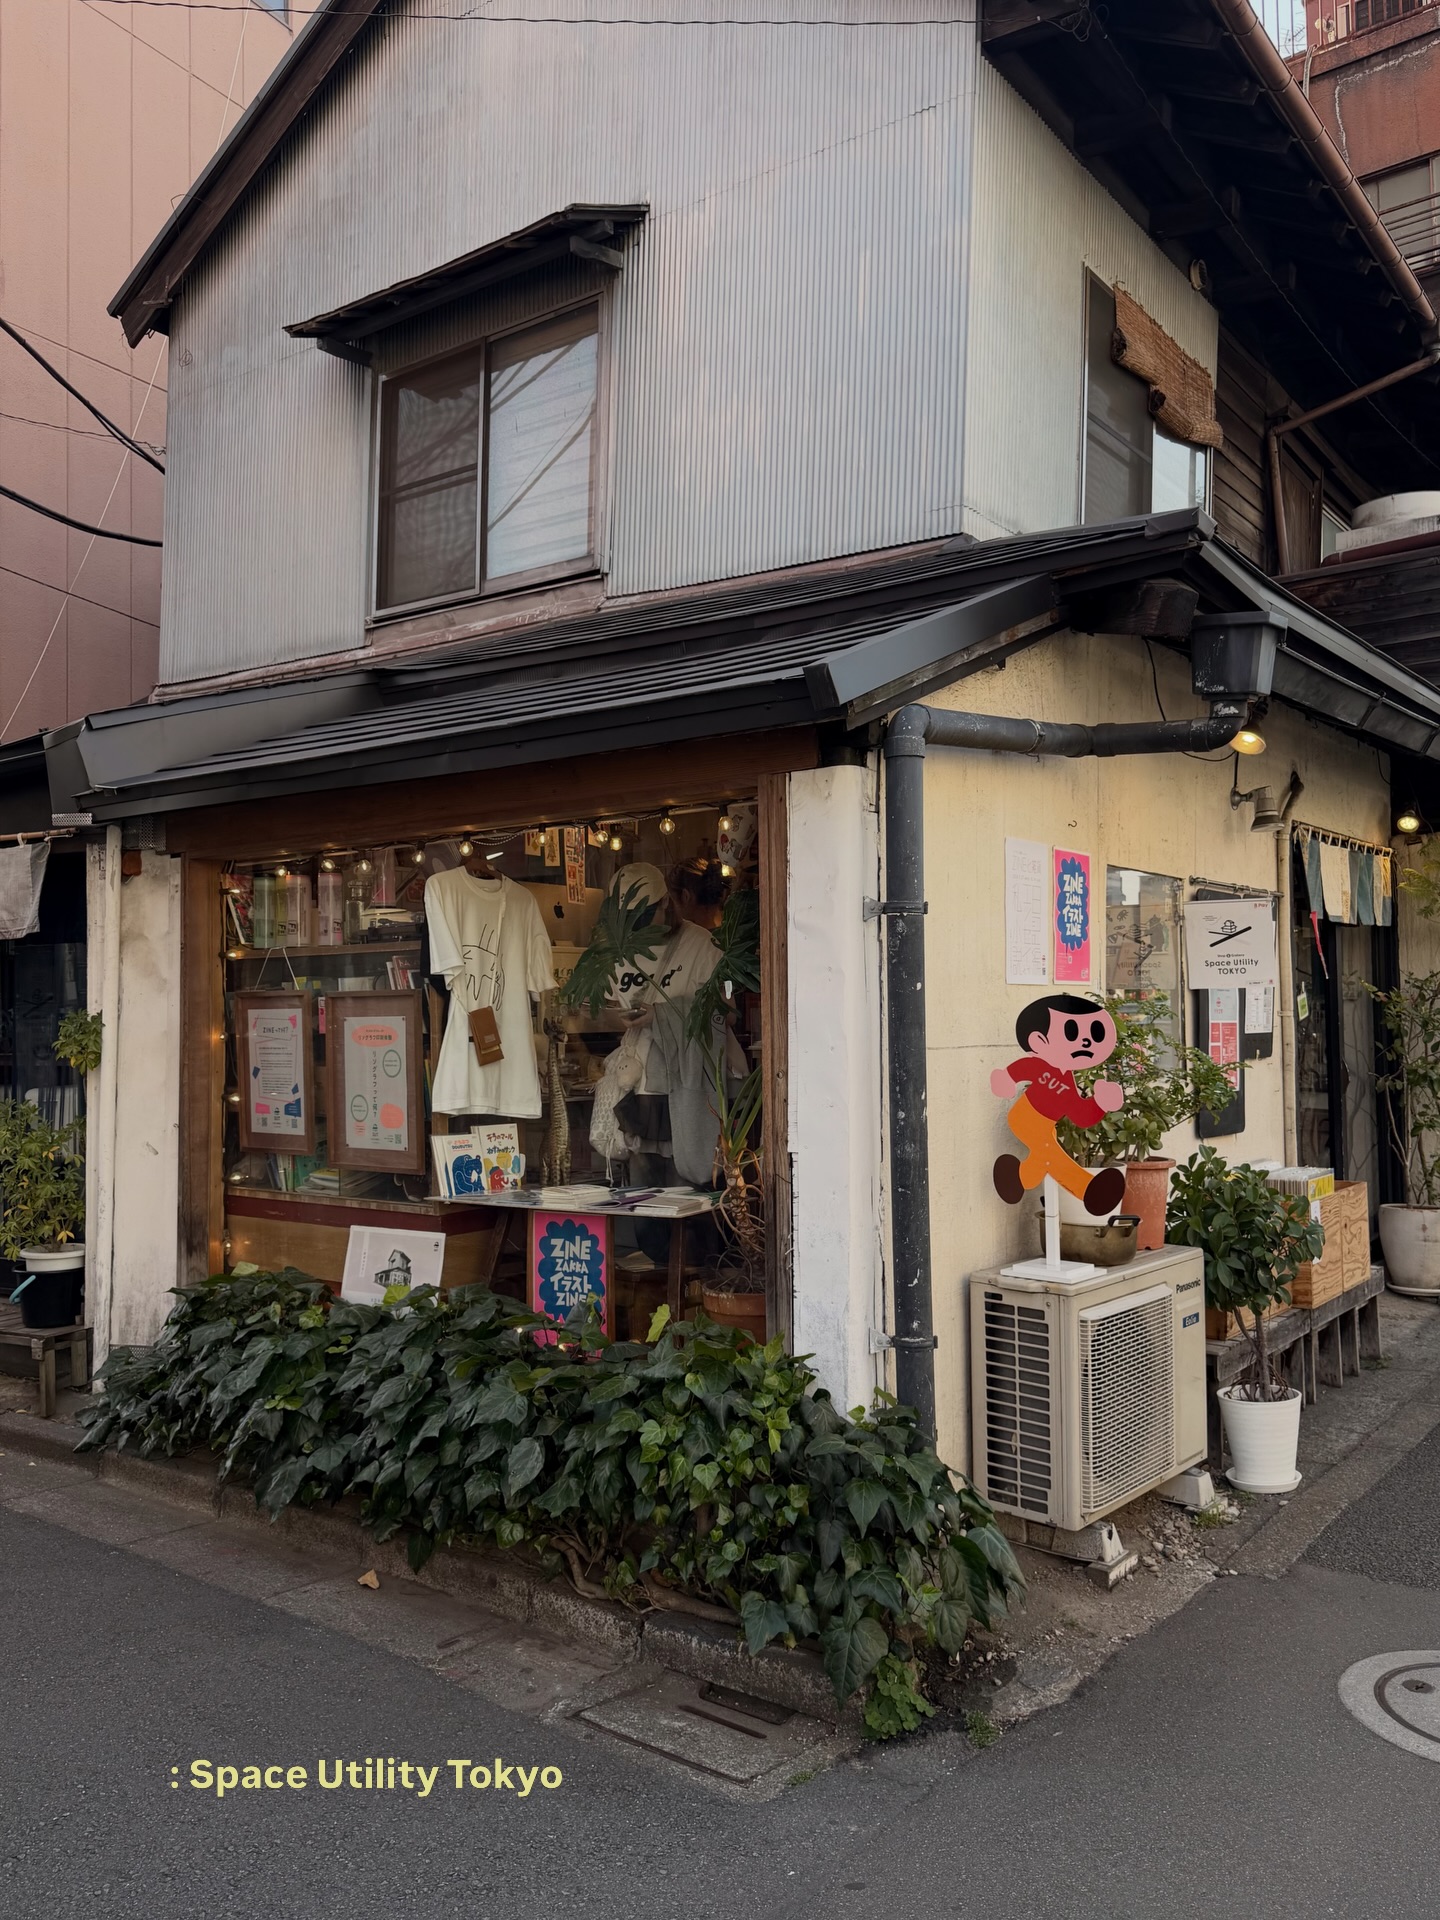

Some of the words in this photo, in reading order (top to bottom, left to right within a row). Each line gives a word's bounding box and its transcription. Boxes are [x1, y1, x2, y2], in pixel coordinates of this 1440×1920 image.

[1063, 872, 1084, 895] ZINE
[1063, 904, 1084, 923] イラスト
[1066, 923, 1082, 937] ZINE
[1218, 967, 1247, 975] TOKYO
[1233, 958, 1259, 967] Utility
[1038, 1072, 1070, 1095] SUT
[550, 1236, 591, 1260] ZINE
[555, 1259, 589, 1274] ZAKKA
[550, 1272, 592, 1293] イラスト
[1176, 1277, 1201, 1294] Panasonic
